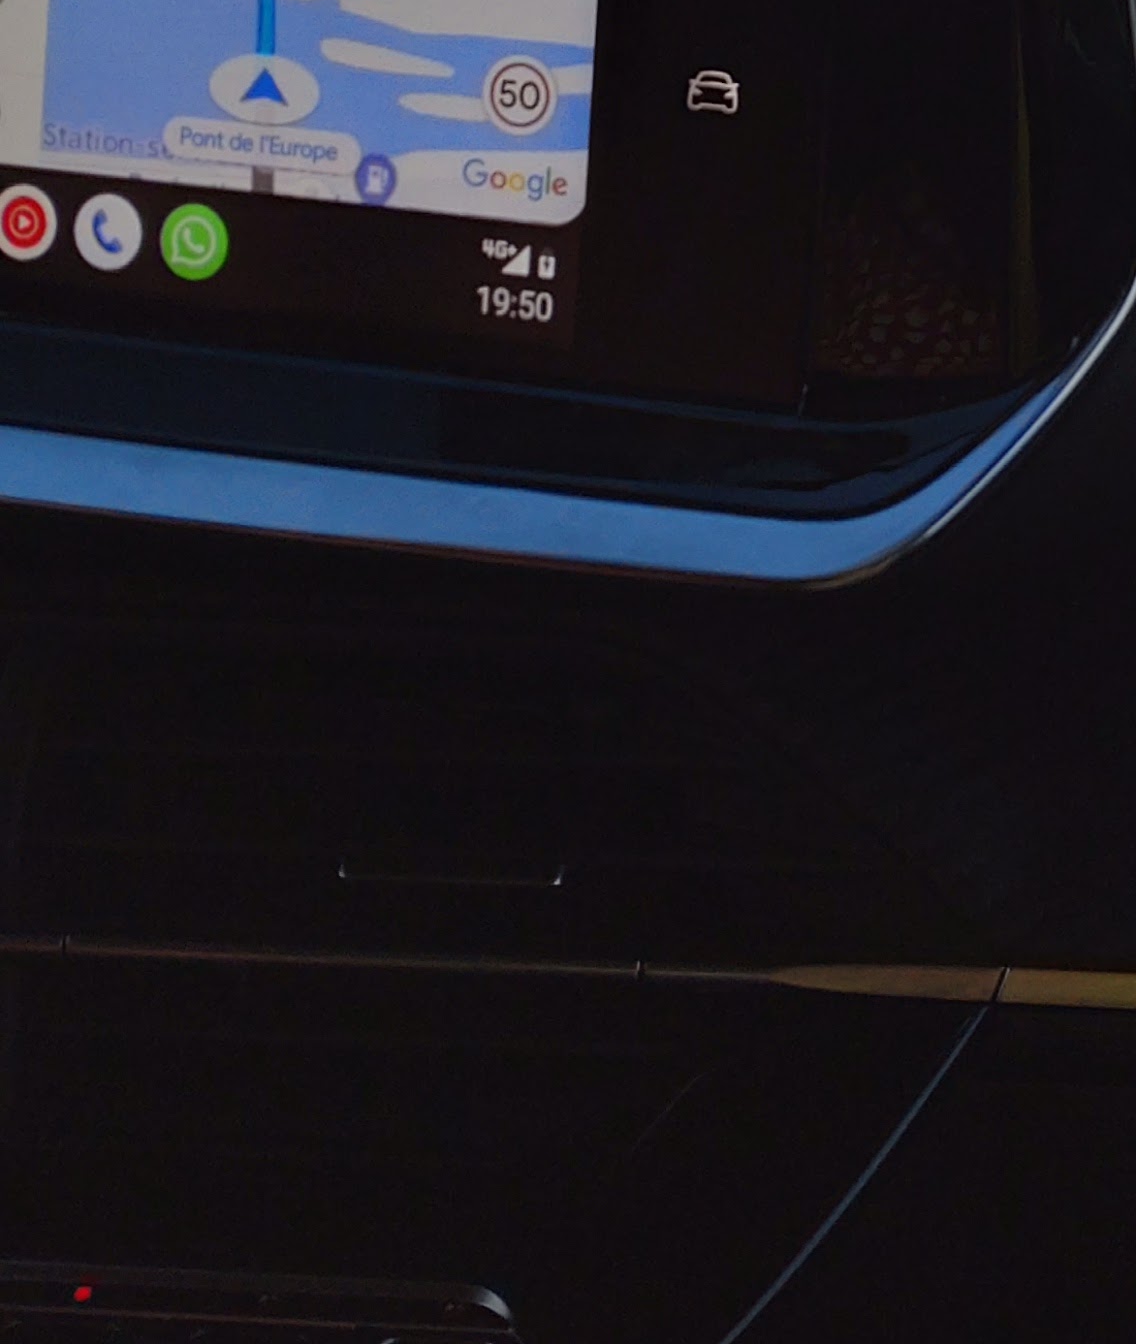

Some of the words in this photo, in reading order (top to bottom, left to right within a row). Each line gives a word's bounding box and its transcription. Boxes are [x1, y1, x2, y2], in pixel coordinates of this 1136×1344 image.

[499, 79, 540, 110] 50
[179, 125, 225, 150] Pont
[229, 132, 254, 152] de
[259, 134, 338, 164] l'Europe
[462, 158, 568, 202] Google
[476, 285, 554, 322] 19:50
